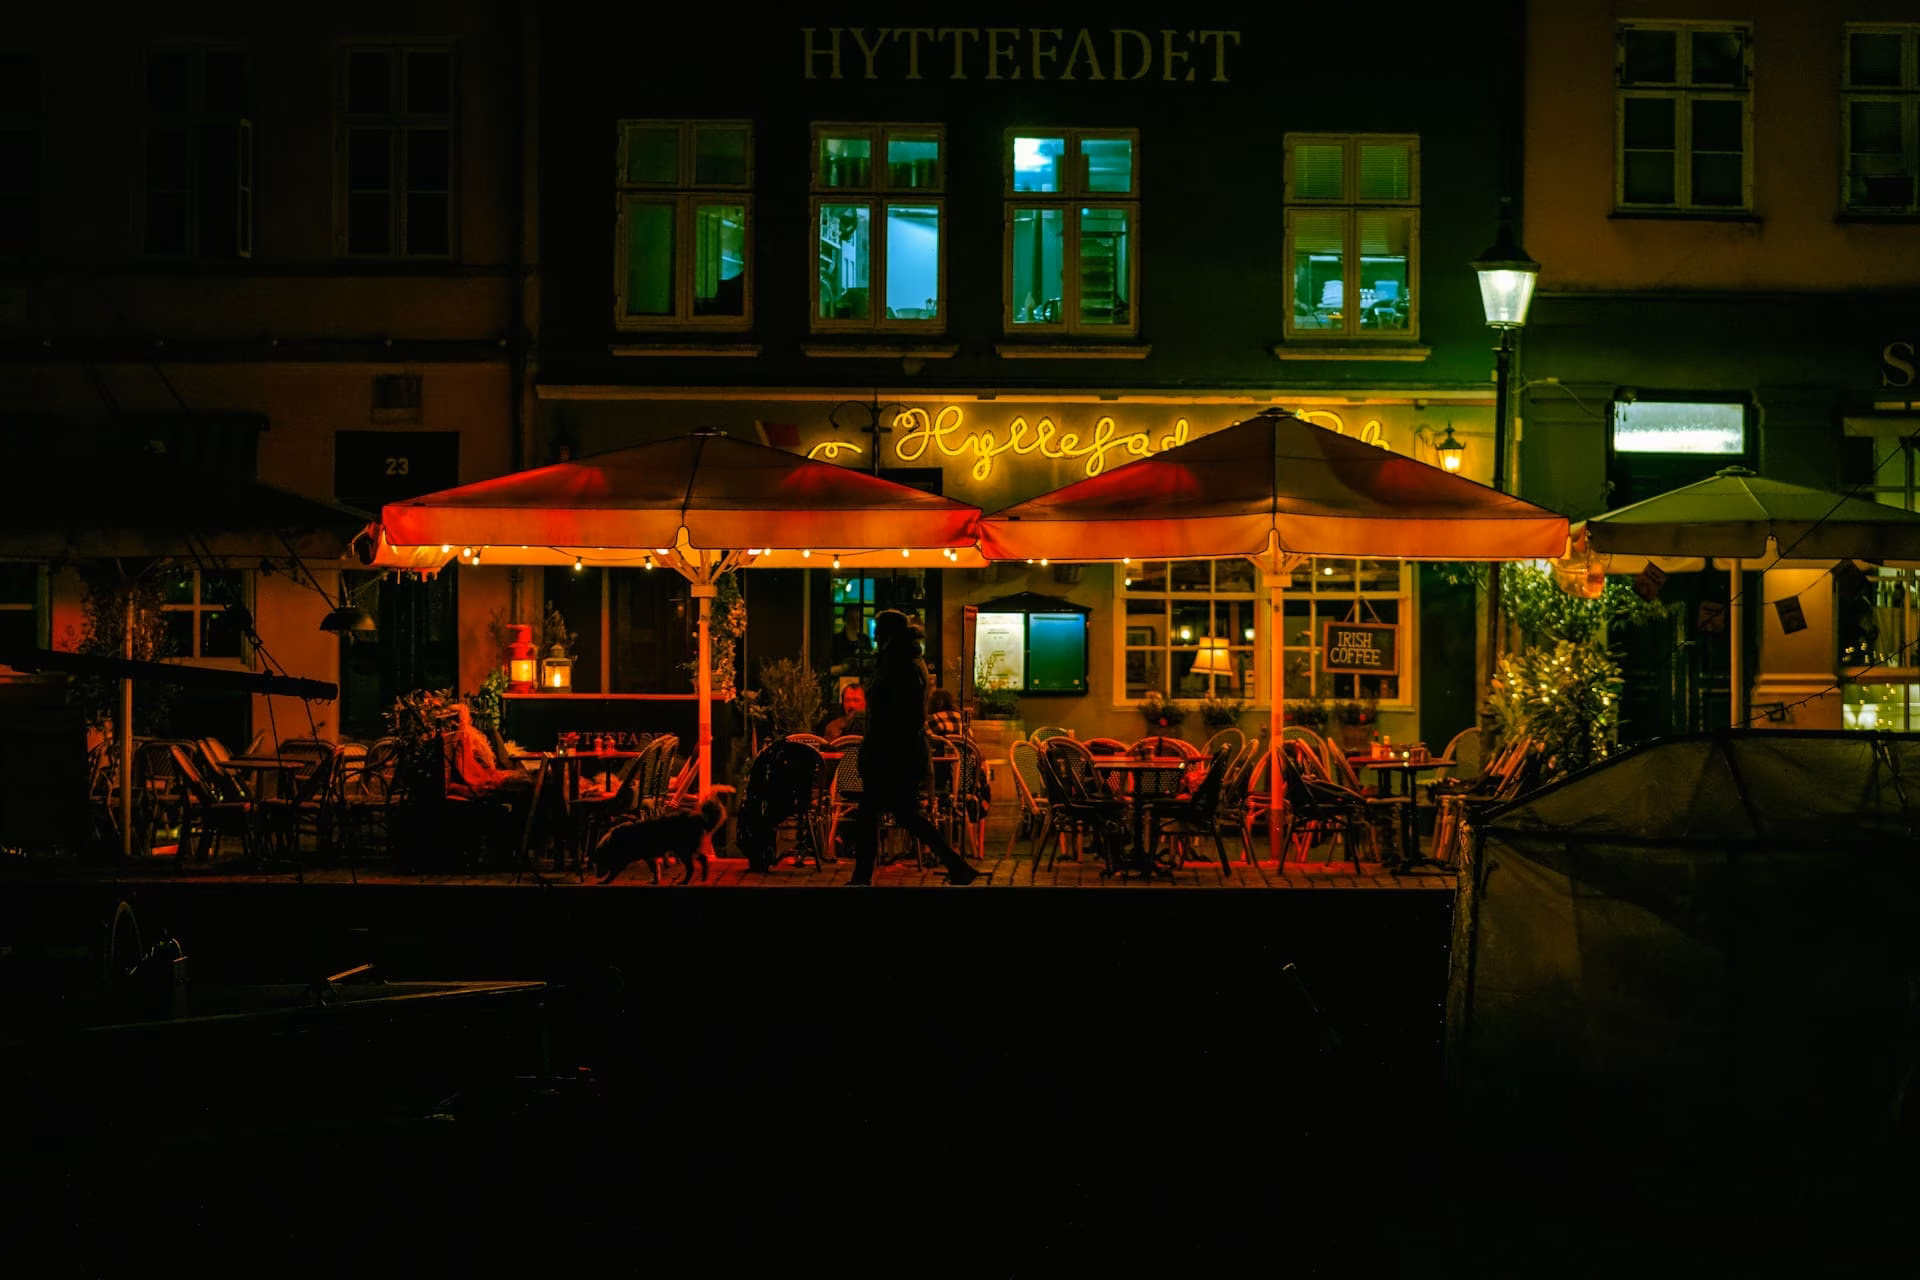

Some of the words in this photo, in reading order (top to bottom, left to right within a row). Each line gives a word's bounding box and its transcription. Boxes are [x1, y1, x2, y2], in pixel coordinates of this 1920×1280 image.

[801, 27, 1241, 82] HYTTEFADET
[385, 457, 409, 476] 23
[1338, 631, 1373, 648] IRISH
[1330, 647, 1381, 666] COFFEE
